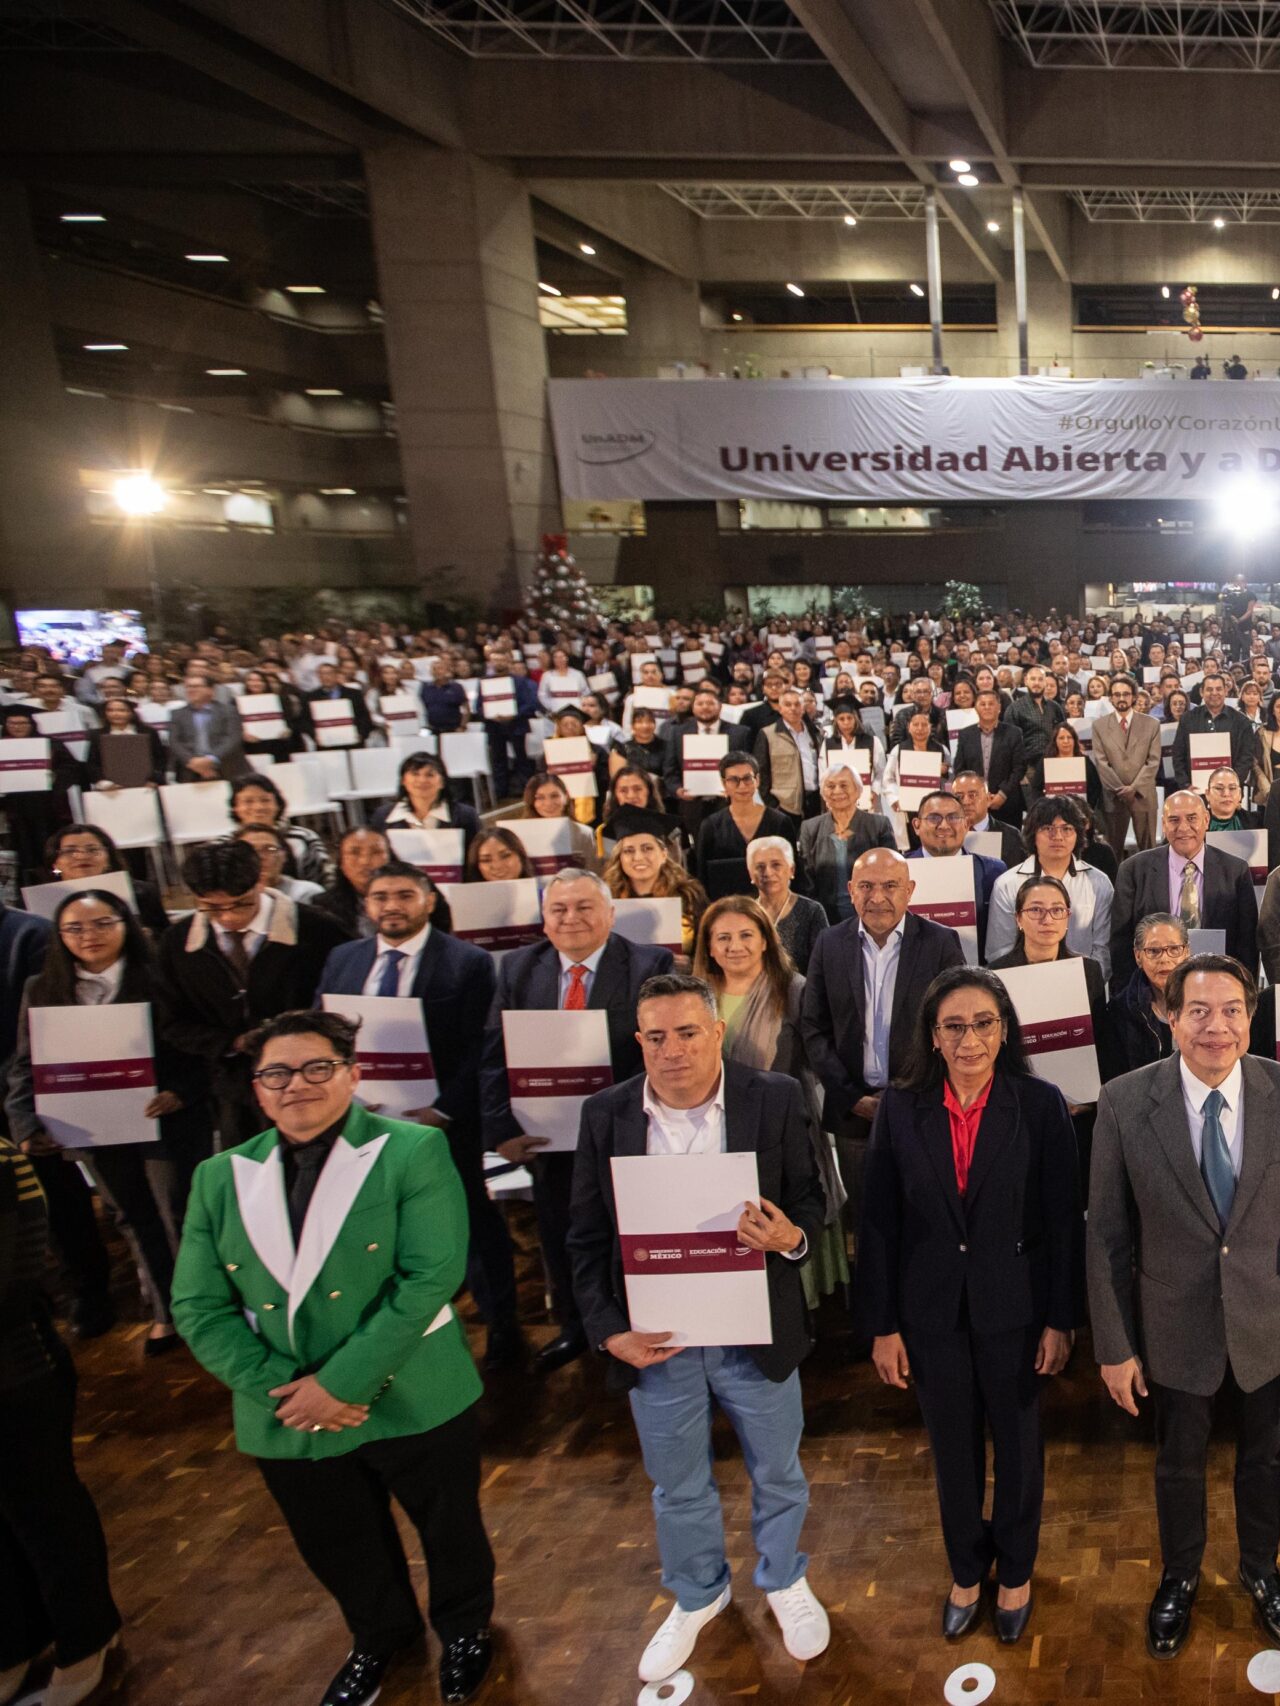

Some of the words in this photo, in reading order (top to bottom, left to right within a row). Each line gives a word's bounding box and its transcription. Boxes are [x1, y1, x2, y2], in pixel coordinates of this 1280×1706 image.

[719, 445, 988, 475] Universidad
[1001, 445, 1167, 475] Abierta
[1180, 451, 1206, 479] y
[1218, 452, 1244, 475] a
